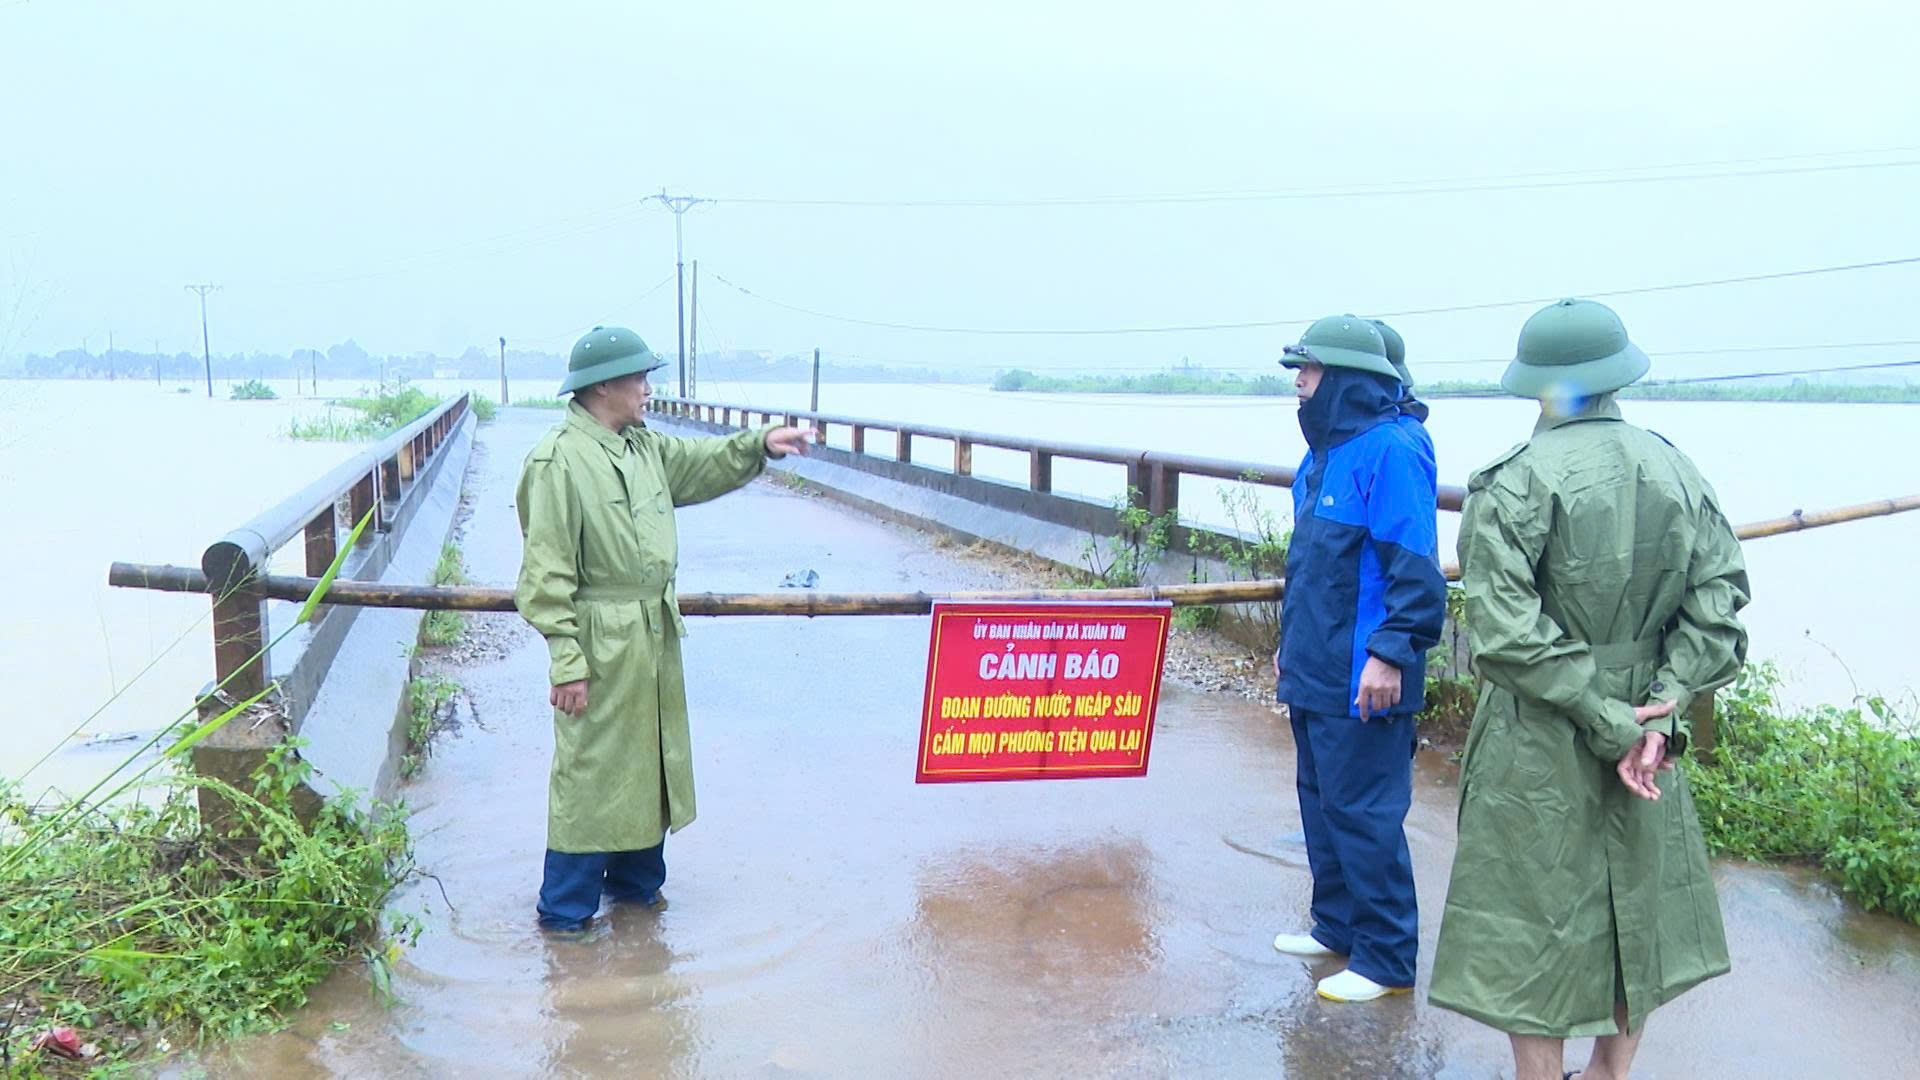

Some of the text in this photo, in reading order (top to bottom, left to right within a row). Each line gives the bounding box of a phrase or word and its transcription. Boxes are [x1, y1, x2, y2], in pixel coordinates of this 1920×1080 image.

[973, 617, 988, 640] ỦY
[988, 623, 1012, 640] BAN
[1012, 620, 1042, 640] NHÂN
[1042, 621, 1065, 640] DÂN
[1080, 622, 1109, 640] XUÂN
[979, 642, 1119, 680] CẢNH BÁO
[941, 689, 1142, 724] ĐOẠN ĐƯỜNG NƯỚC NGẬP SÂU
[932, 725, 1142, 759] CẤM MỌI PHƯƠNG TIỆN QUA LẠI
